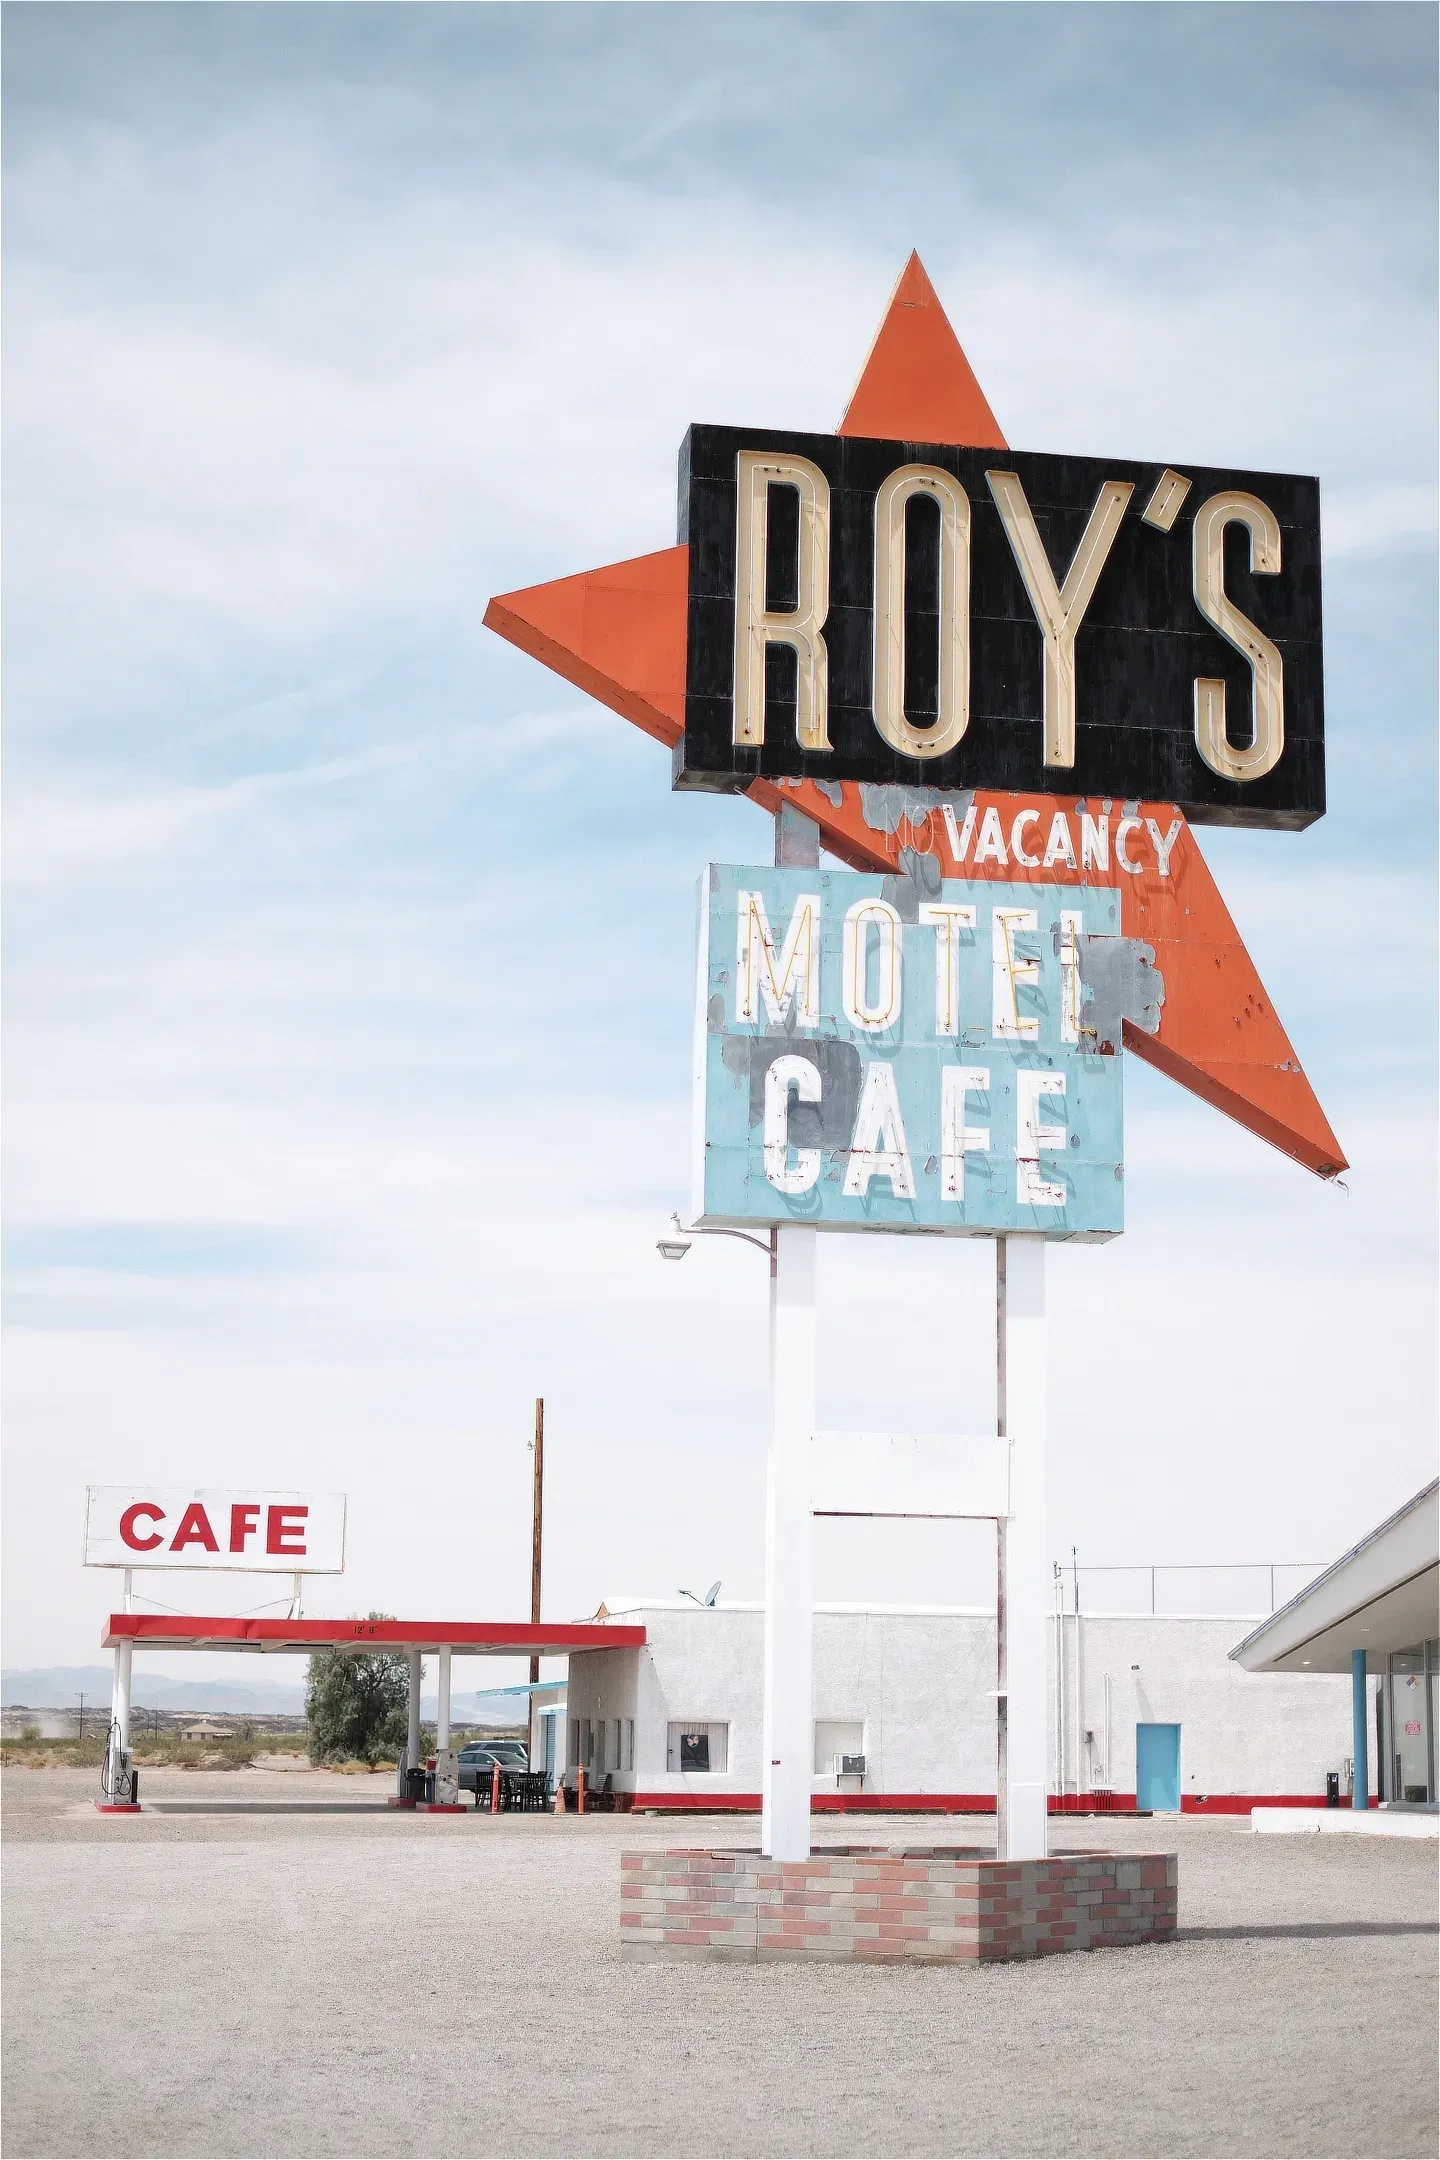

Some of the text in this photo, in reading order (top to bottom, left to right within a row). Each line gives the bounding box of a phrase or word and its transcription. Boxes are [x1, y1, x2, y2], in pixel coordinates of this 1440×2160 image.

[731, 449, 1285, 782] ROY'S
[942, 803, 1184, 877] VACANCY
[735, 889, 1096, 1044] MOTEL
[763, 1054, 1068, 1207] CAFE
[119, 1502, 309, 1556] CAFE
